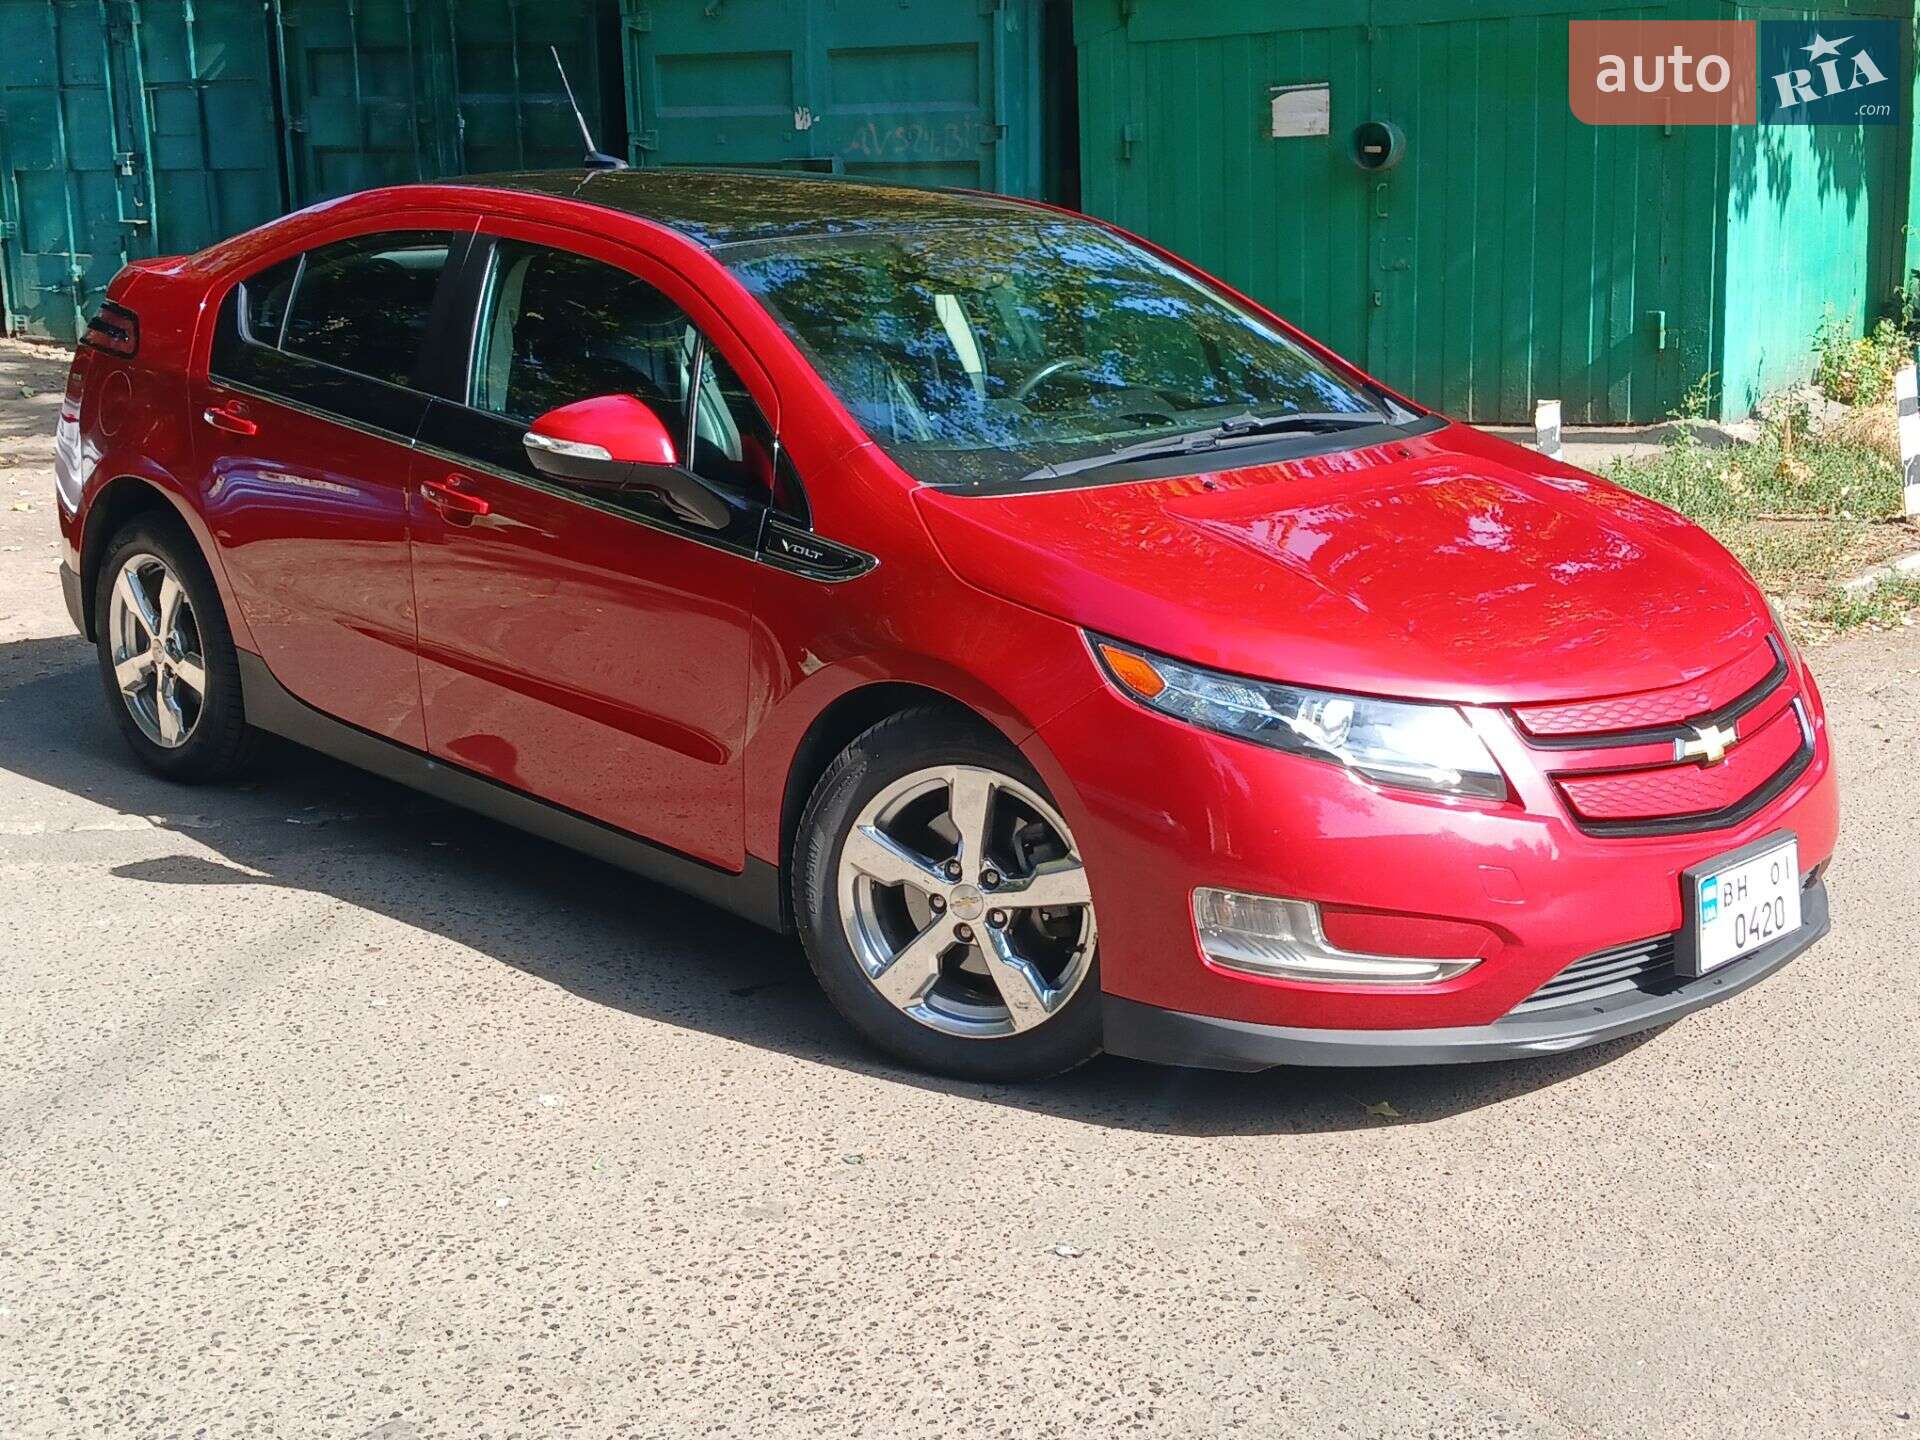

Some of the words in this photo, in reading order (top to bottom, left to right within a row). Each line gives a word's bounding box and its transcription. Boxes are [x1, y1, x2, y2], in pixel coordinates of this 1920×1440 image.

[781, 538, 823, 559] VOLT
[1723, 875, 1748, 907] BH
[1770, 856, 1790, 885] 01
[1735, 896, 1785, 949] 0420
